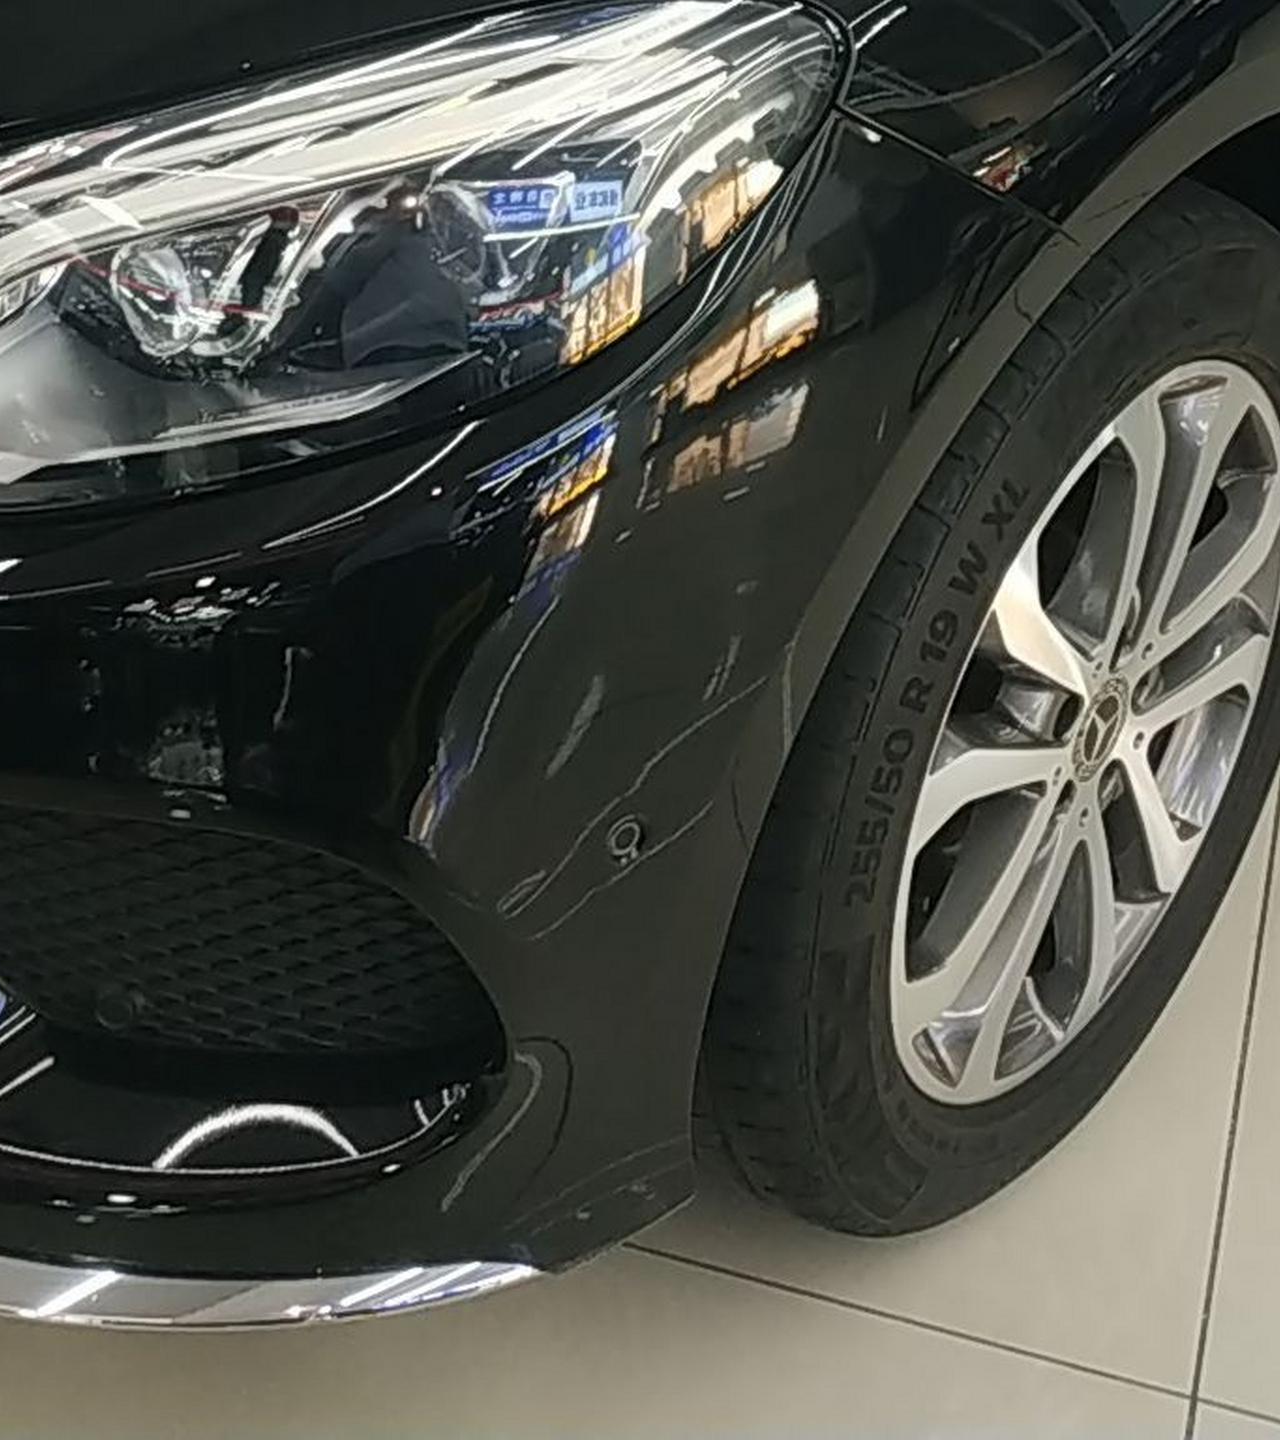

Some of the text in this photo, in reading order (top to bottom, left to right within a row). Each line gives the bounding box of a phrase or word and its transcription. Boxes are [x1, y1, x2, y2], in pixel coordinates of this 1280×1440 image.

[844, 478, 1031, 907] 255/50 R 19 W XL
